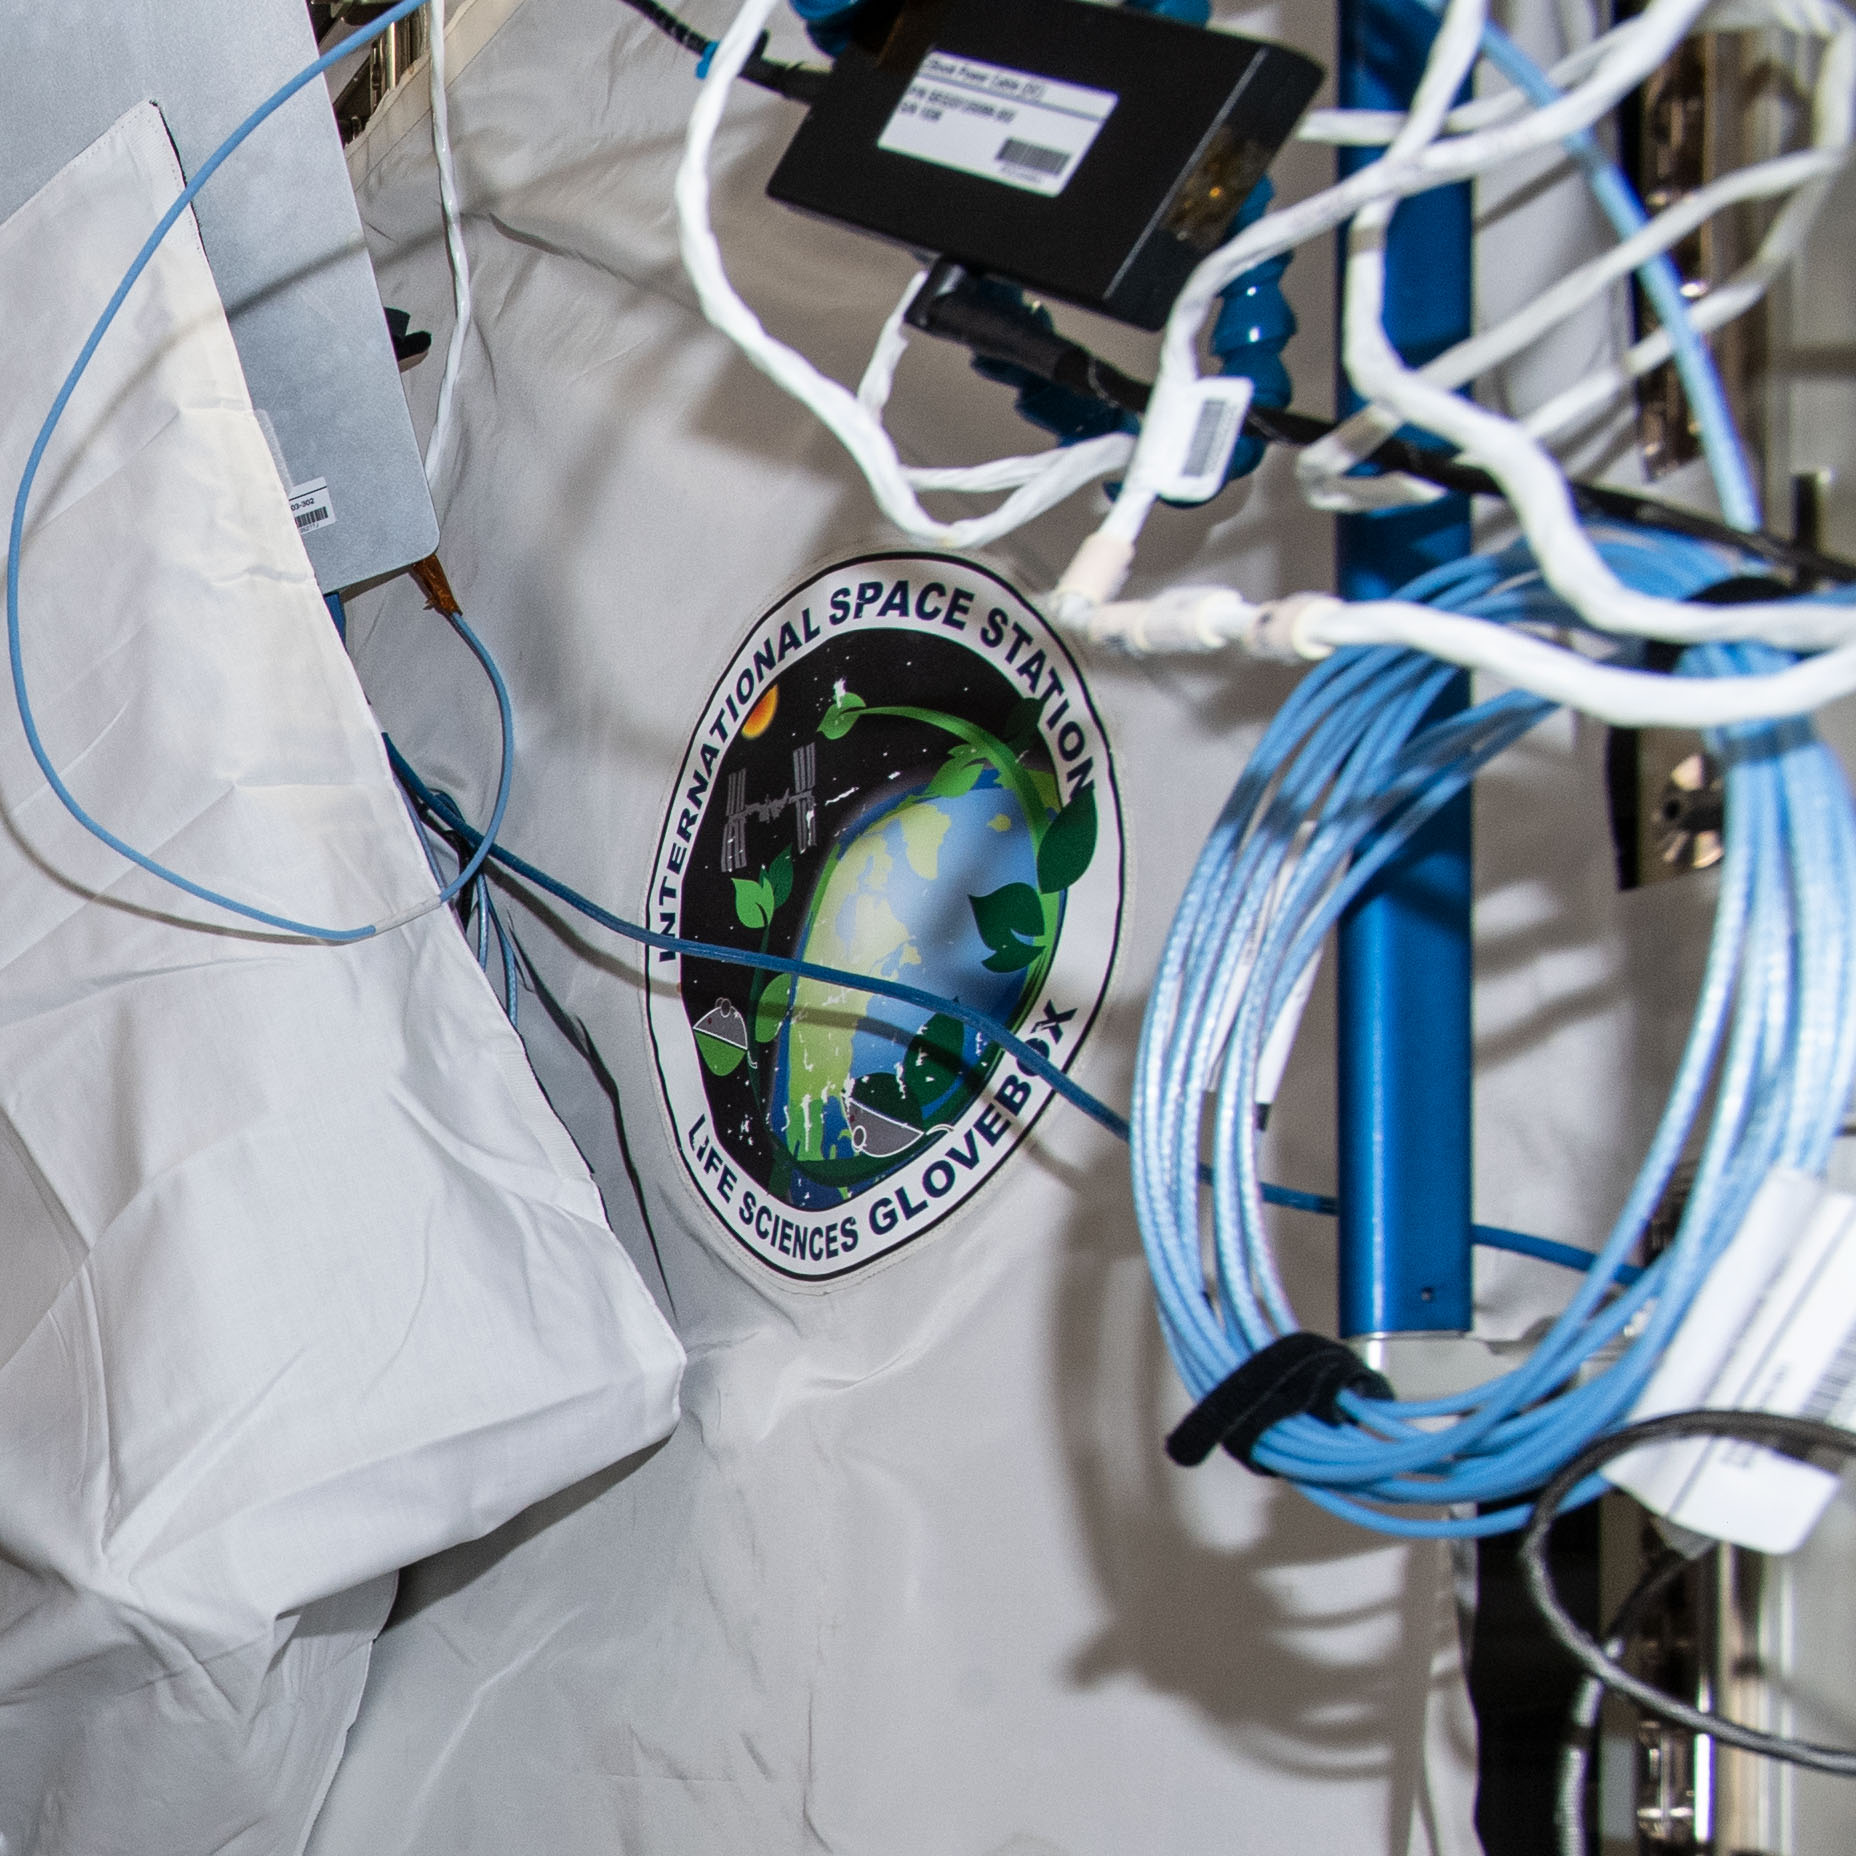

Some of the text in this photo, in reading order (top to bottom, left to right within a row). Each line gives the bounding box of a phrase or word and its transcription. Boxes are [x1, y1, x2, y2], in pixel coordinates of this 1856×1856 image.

[658, 581, 1096, 962] INTERNATIONAL SPACE STATION
[688, 999, 1078, 1262] LIFE SCIENCES GLOVEBOX
